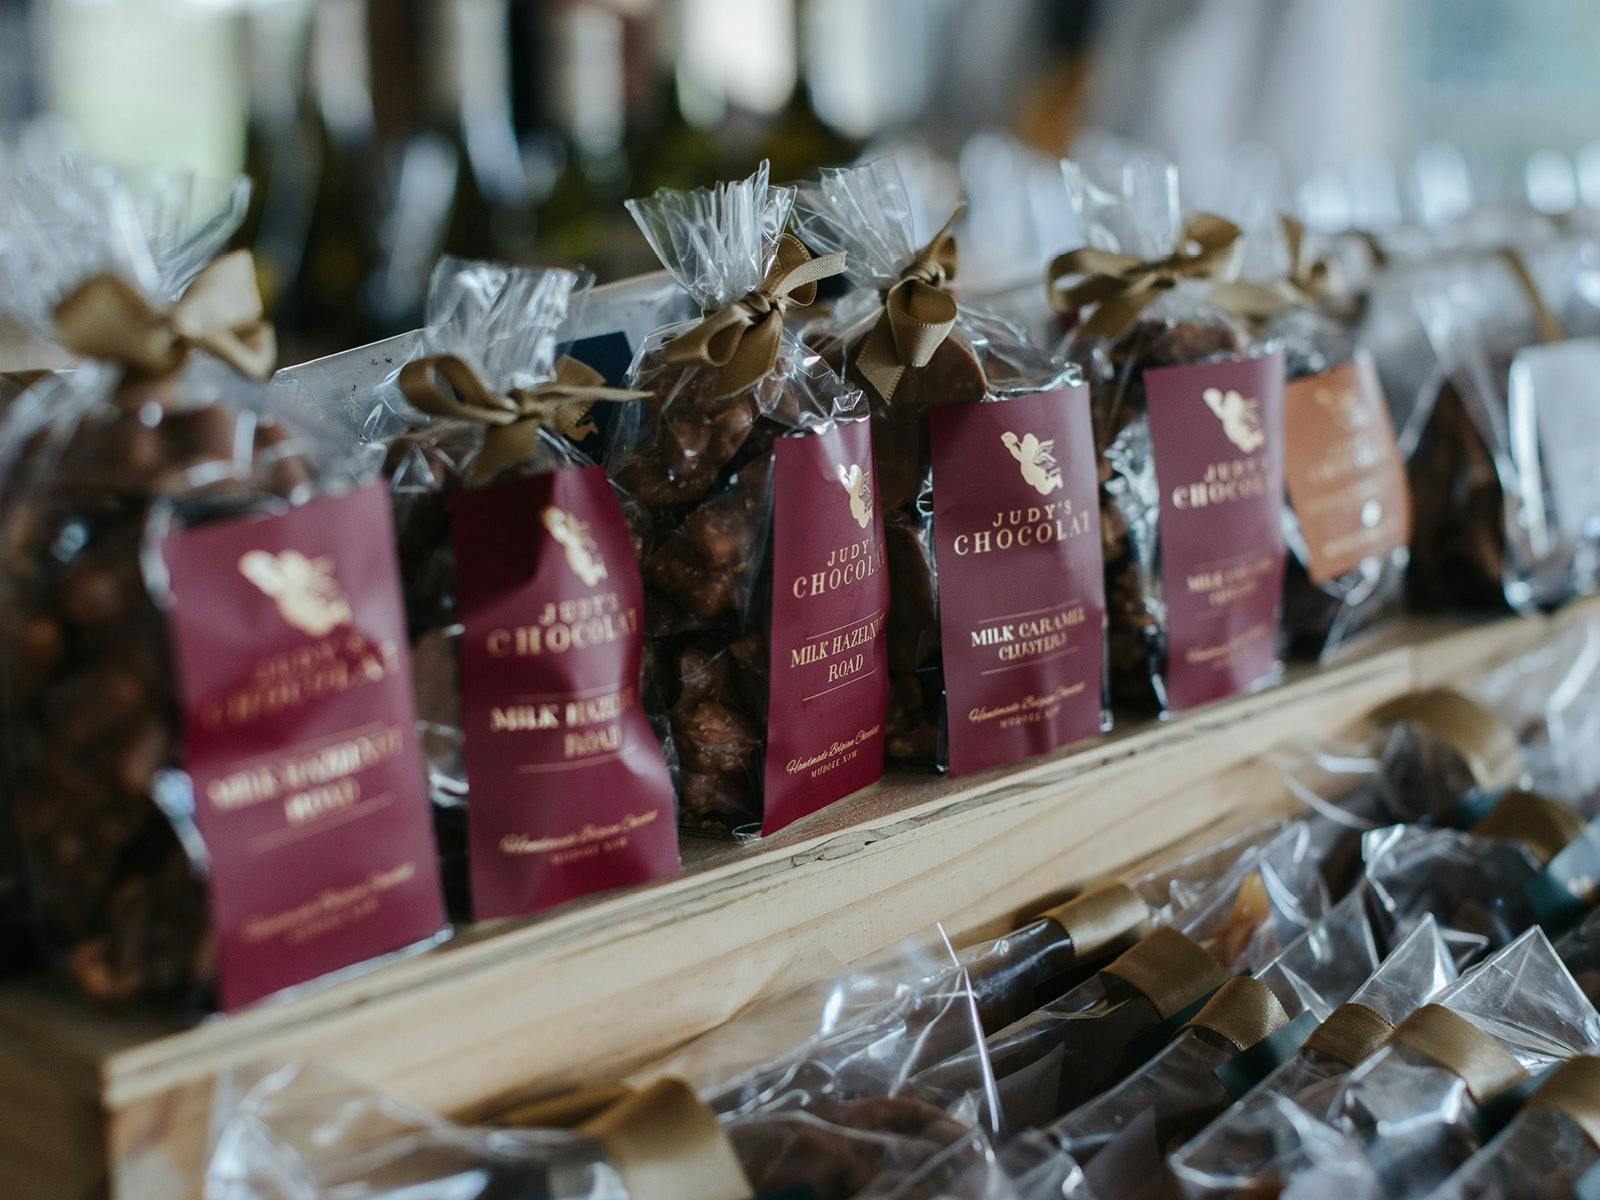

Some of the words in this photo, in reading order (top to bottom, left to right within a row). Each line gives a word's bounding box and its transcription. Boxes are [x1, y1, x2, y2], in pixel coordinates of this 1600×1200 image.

[992, 499, 1073, 527] JUDY'S
[953, 510, 1091, 556] CHOCOLAT
[971, 624, 1015, 648] MILK
[790, 640, 829, 668] MILK
[827, 653, 864, 683] ROAD
